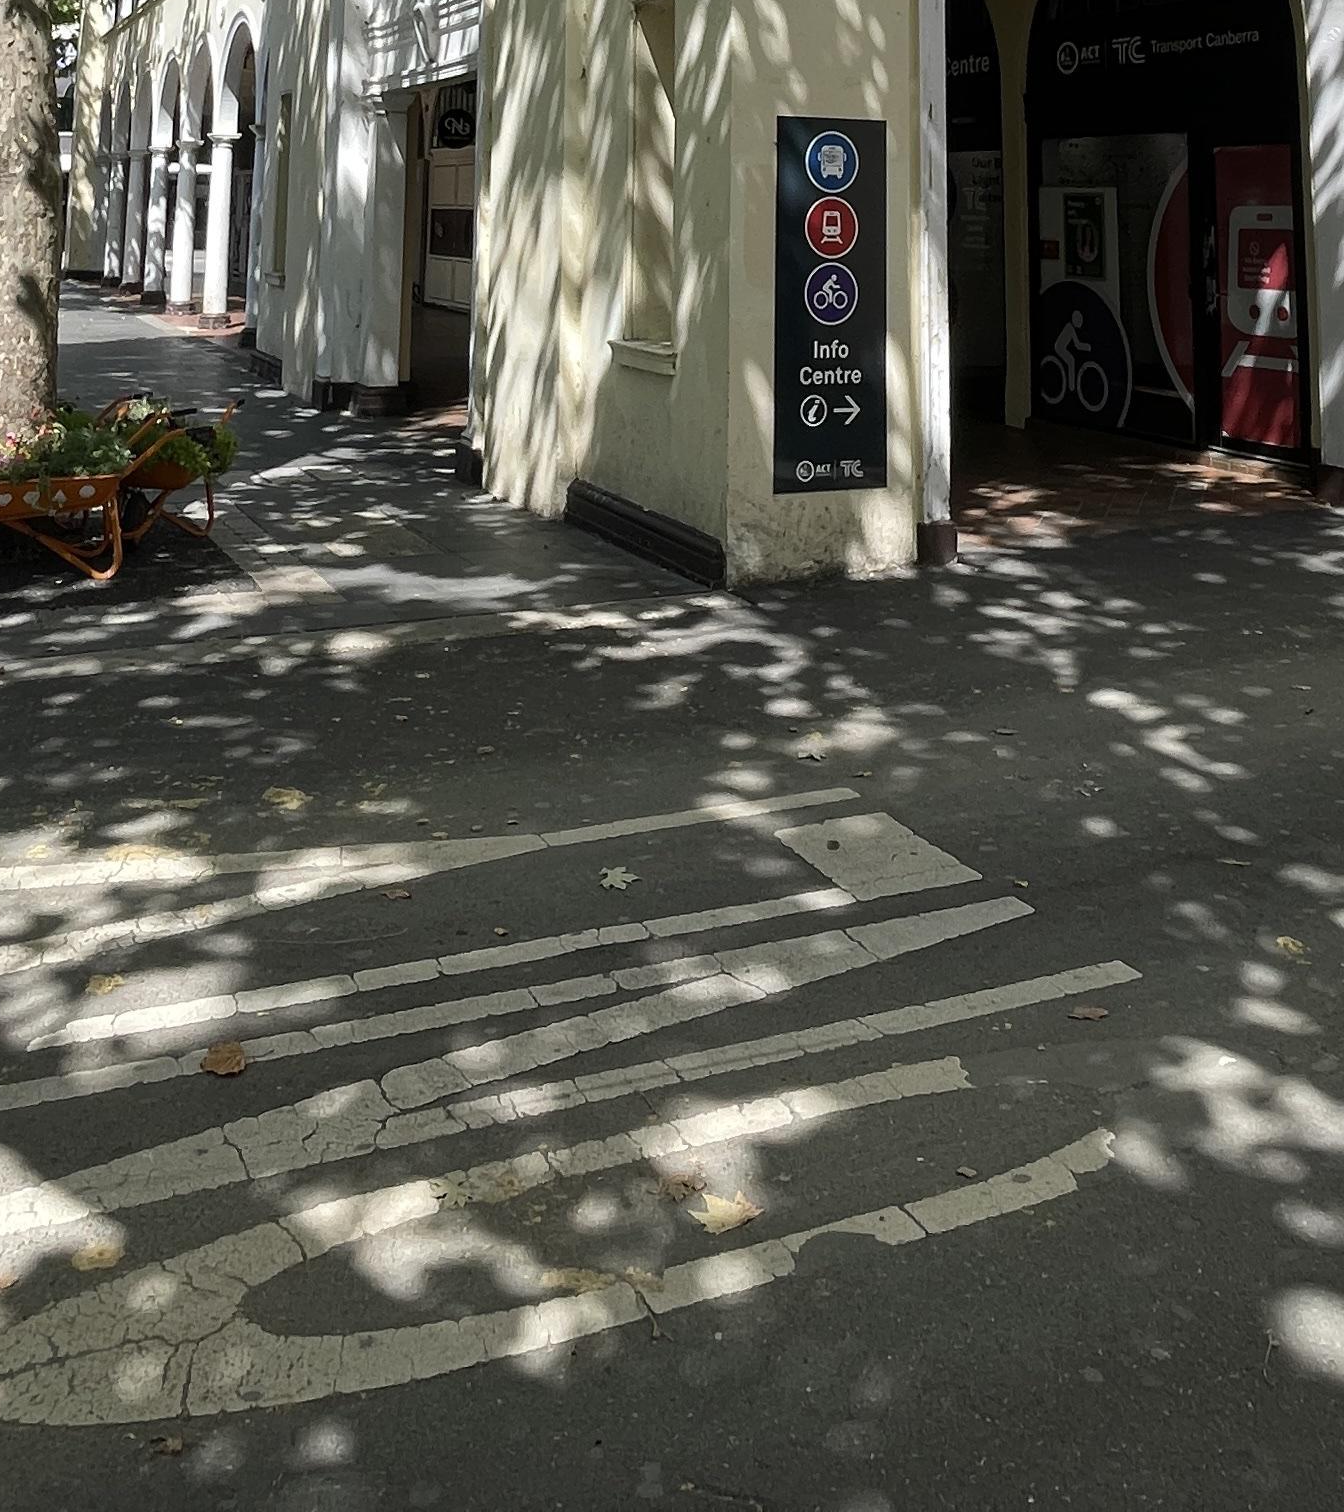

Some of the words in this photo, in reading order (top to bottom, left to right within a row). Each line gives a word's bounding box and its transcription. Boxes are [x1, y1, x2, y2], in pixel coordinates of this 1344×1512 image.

[1150, 36, 1203, 55] Transport
[1205, 29, 1260, 48] Canberra
[813, 340, 849, 360] Info
[799, 366, 862, 386] Centre
